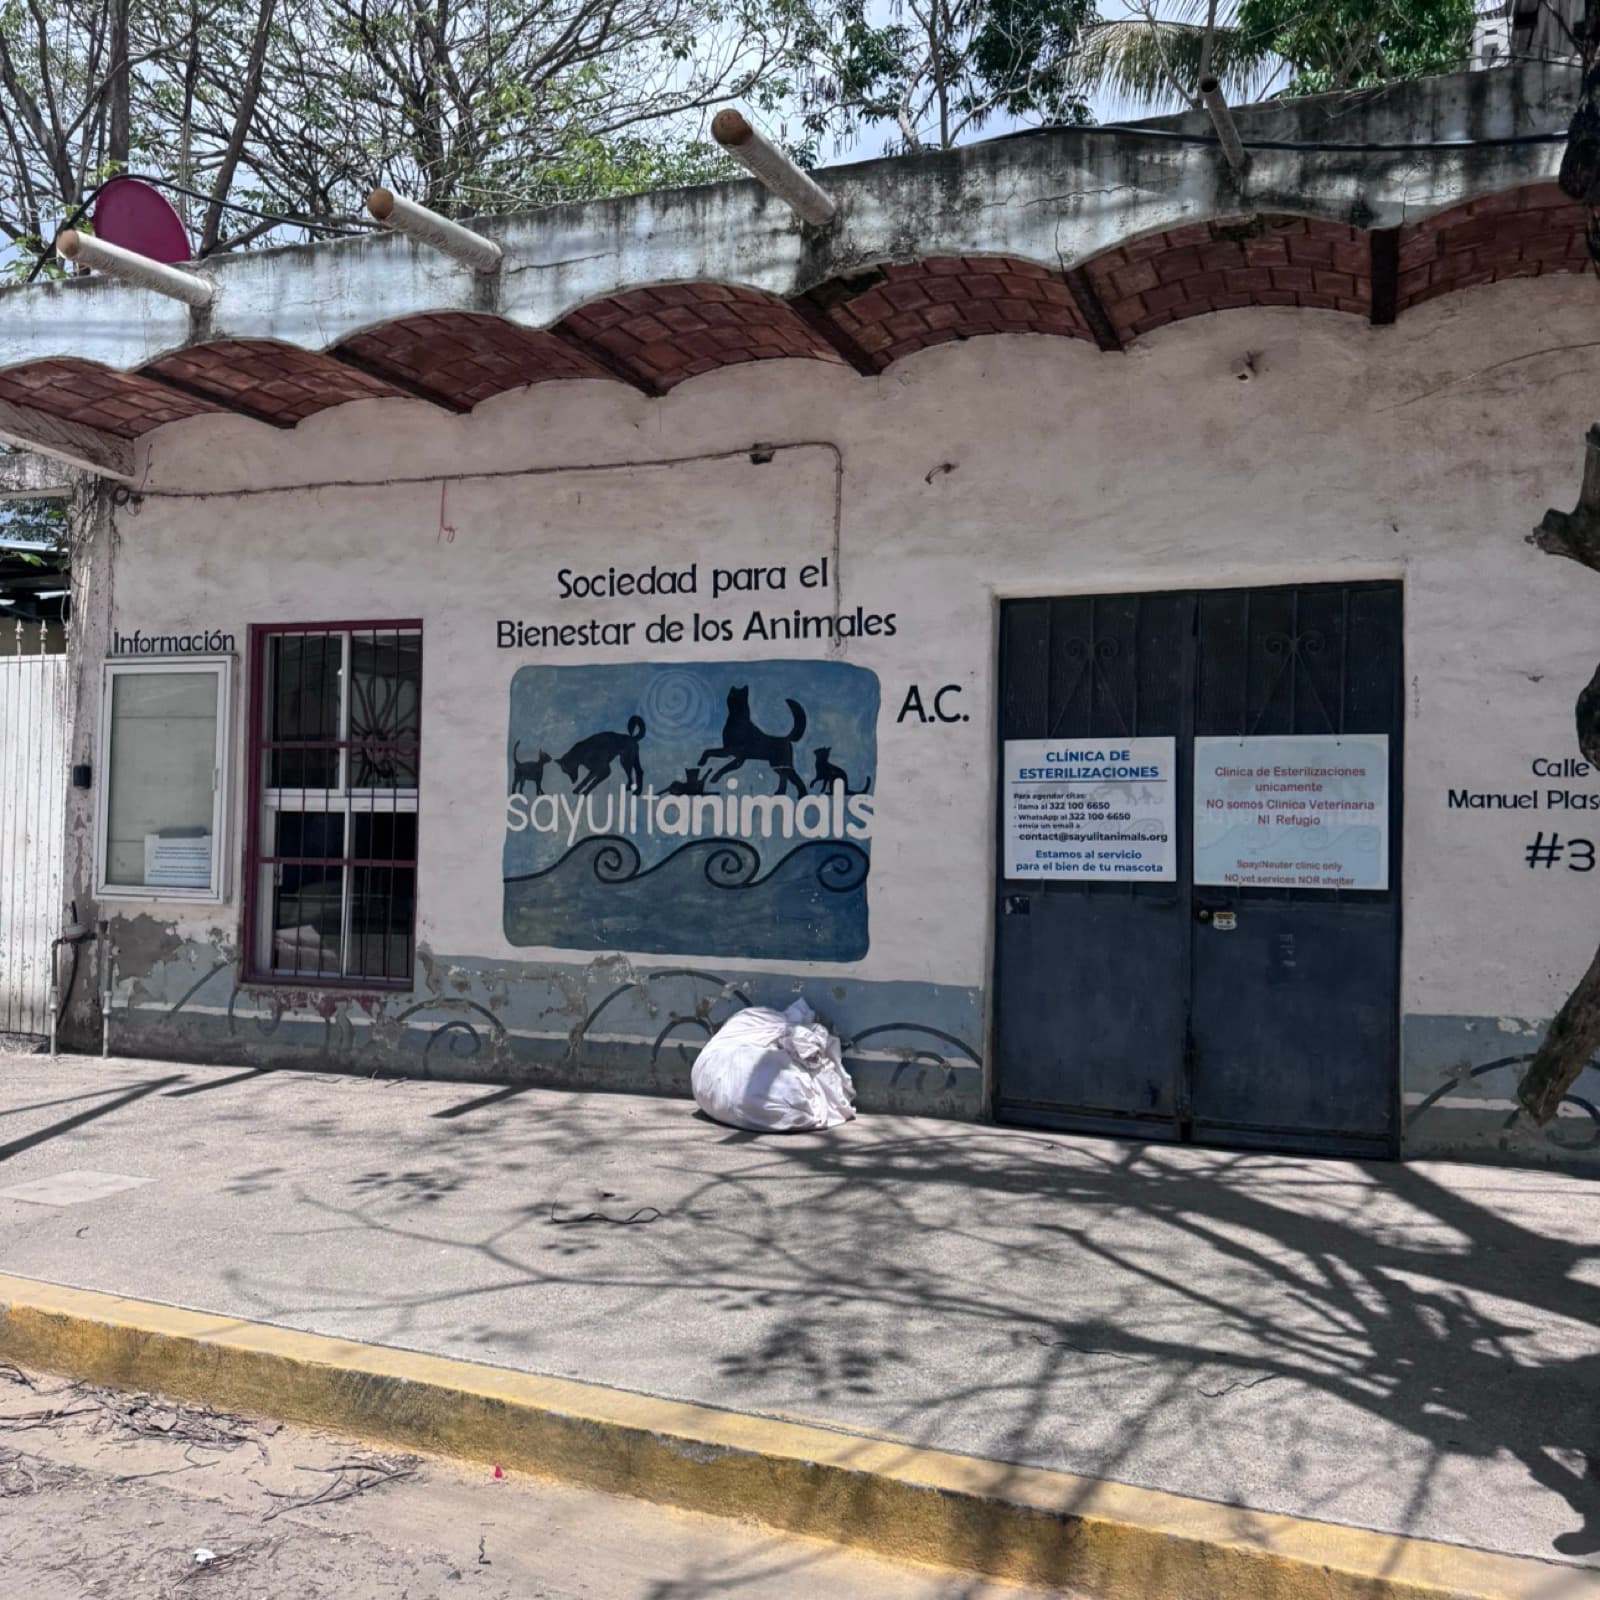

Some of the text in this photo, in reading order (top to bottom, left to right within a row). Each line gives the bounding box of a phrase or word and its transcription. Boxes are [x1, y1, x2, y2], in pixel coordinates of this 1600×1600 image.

[557, 557, 828, 599] Sociedad para el
[496, 606, 897, 649] Bienestar de los Animales
[113, 627, 235, 654] Información
[896, 684, 970, 724] A.C.
[1046, 749, 1130, 763] CLÍNICA DE
[1019, 766, 1159, 780] ESTERILIZACIONES
[1256, 766, 1270, 777] de
[1274, 766, 1366, 777] Esterilizaciones
[1531, 758, 1590, 778] Calle
[1050, 801, 1067, 810] 322
[1068, 801, 1084, 810] 100
[1086, 801, 1110, 810] 6650
[1206, 799, 1224, 809] NO
[1227, 801, 1264, 810] somos
[1309, 799, 1375, 811] Veterinaria
[1448, 789, 1538, 809] Manuel
[504, 777, 875, 847] sayulitanimals
[1069, 812, 1085, 821] 322
[1088, 812, 1104, 821] 100
[1107, 812, 1131, 821] 6650
[1257, 814, 1320, 827] NI Refugio
[1019, 832, 1168, 843] contact@sayulitanimals.org
[1035, 850, 1142, 860] Estamos al servicio
[1016, 862, 1163, 873] para el bien de tu mascota
[1224, 873, 1239, 882] NO
[1298, 875, 1320, 884] NOR
